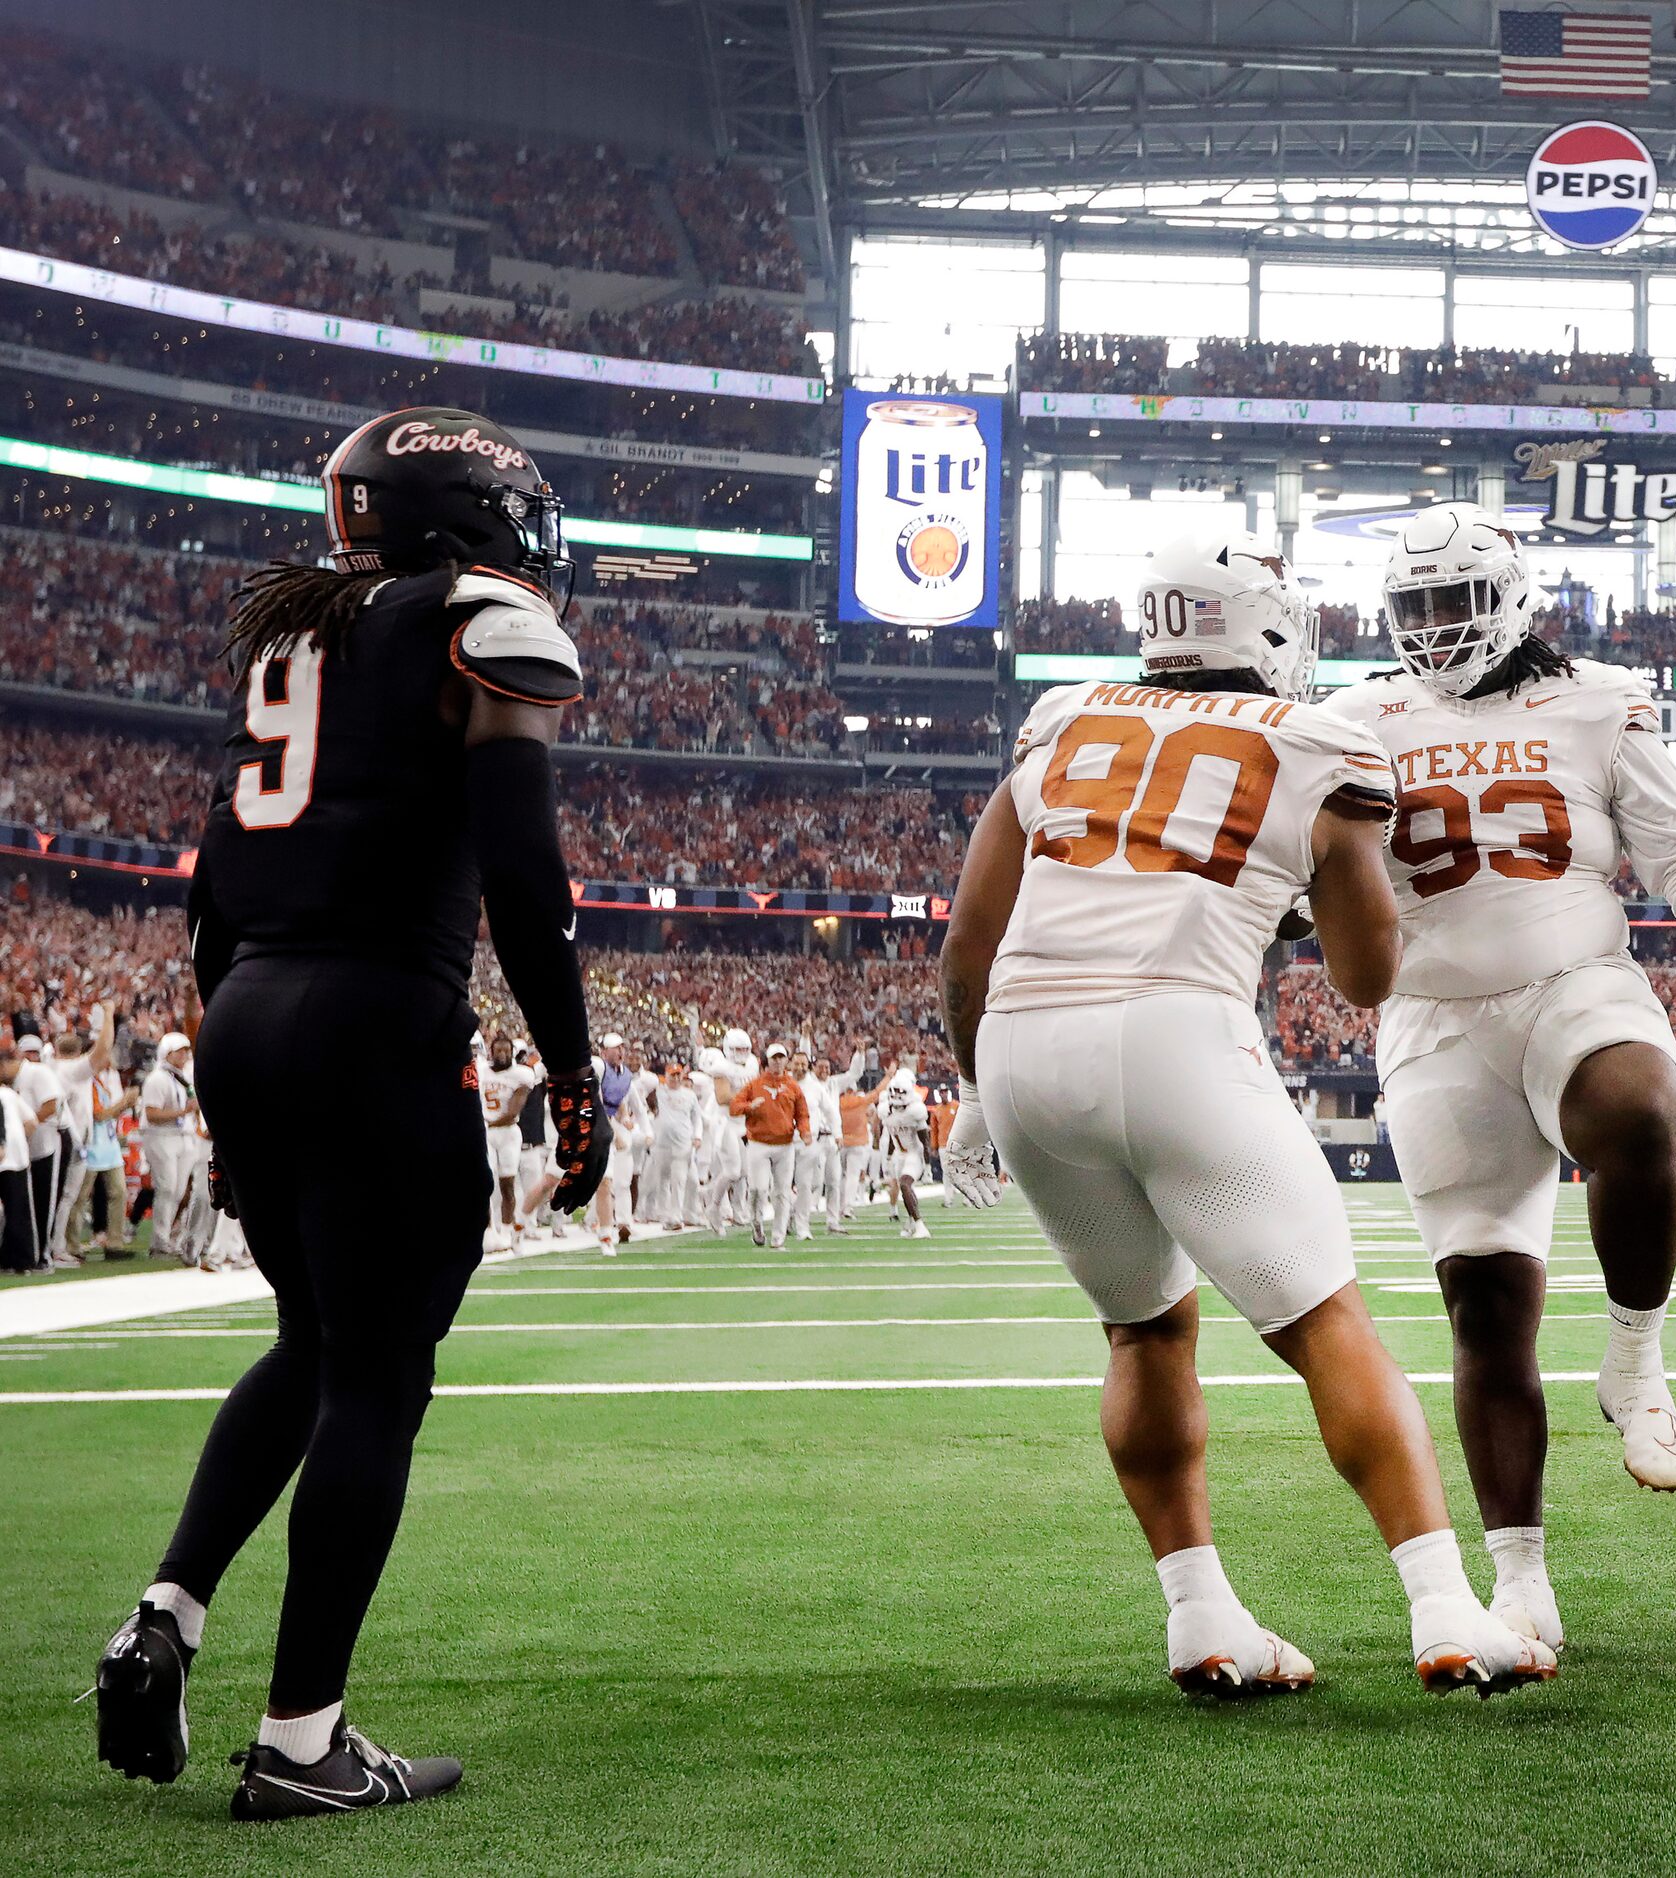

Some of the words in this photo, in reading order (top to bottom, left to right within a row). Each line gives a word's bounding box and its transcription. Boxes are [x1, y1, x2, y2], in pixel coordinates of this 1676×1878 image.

[1536, 171, 1648, 200] PEPSI
[386, 421, 527, 470] Cowboys
[353, 485, 369, 514] 9
[885, 449, 981, 506] Lite
[349, 554, 385, 571] STATE
[1410, 564, 1438, 576] HORNS
[1145, 589, 1188, 639] 90
[1145, 655, 1203, 671] LONGHORNS
[1084, 683, 1257, 718] MURPHY
[1260, 702, 1295, 728] II
[233, 629, 327, 831] 9
[1398, 740, 1549, 785] TEXAS
[1031, 715, 1279, 888] 90
[1391, 779, 1573, 899] 93
[484, 1091, 501, 1112] 5
